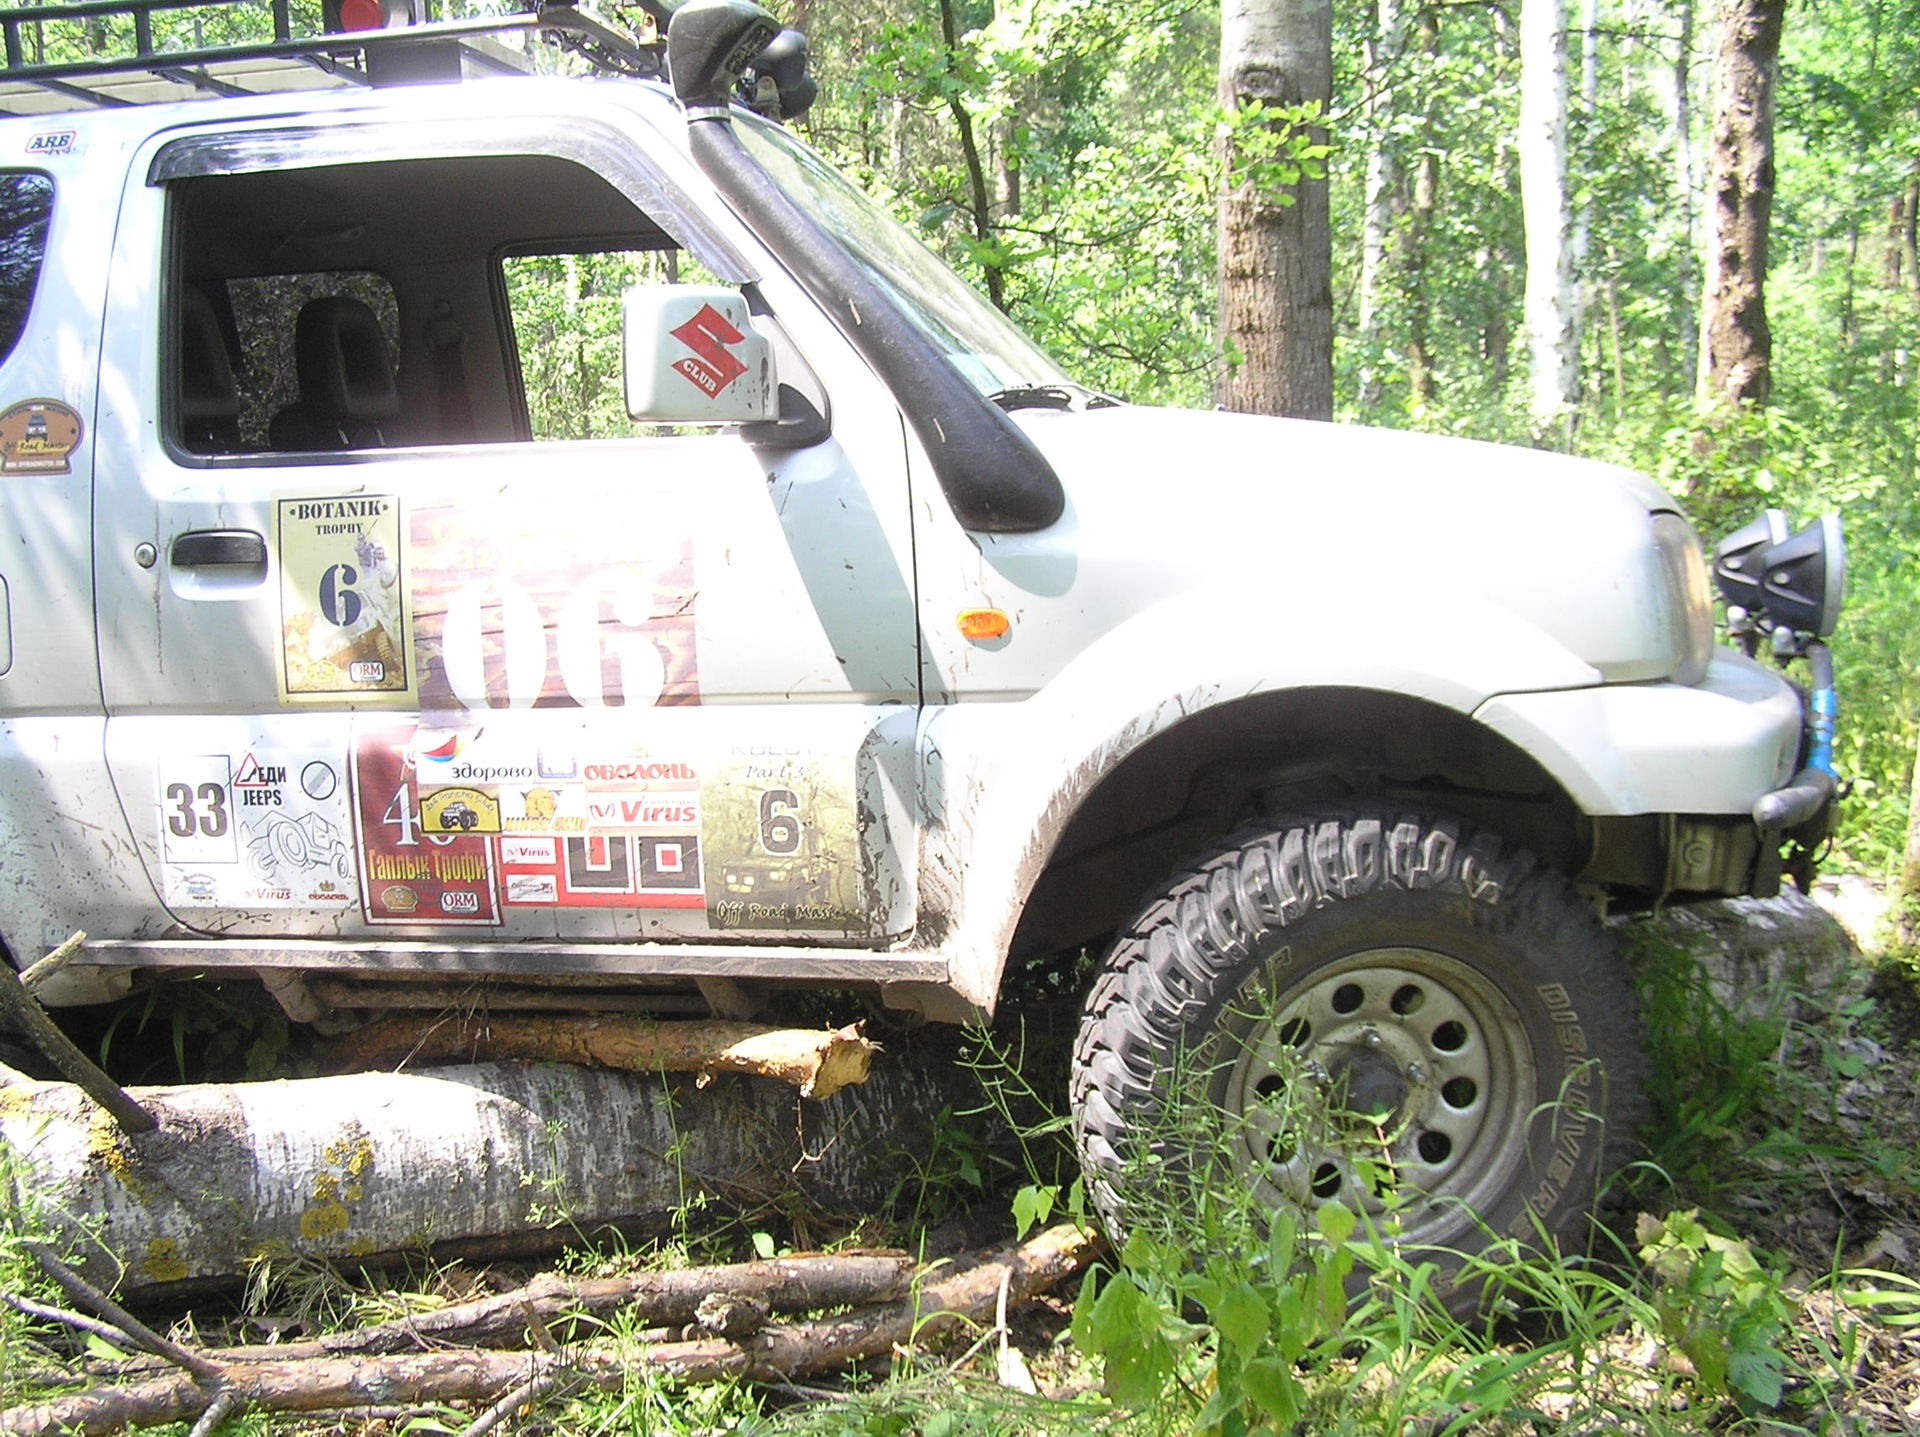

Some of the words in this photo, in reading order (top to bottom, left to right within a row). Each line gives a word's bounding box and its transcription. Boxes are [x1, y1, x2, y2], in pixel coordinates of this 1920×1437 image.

[30, 134, 71, 150] ARB
[683, 360, 717, 392] CLUB
[297, 500, 381, 520] BOTANIK
[315, 523, 364, 536] TROPHY
[319, 563, 362, 627] 6
[442, 570, 665, 712] 06
[354, 664, 382, 676] ORM
[451, 762, 533, 782] здорово
[747, 765, 786, 779] Part
[793, 766, 804, 779] 3
[243, 789, 283, 807] JEEPS
[167, 782, 228, 838] 33
[620, 800, 696, 822] Virus
[758, 786, 803, 856] 6
[519, 847, 550, 857] Virus
[368, 849, 431, 880] Гаплык
[431, 849, 487, 883] Трофи
[256, 887, 292, 900] Virus
[443, 893, 476, 906] ORM
[716, 900, 745, 926] Off
[748, 904, 787, 921] Road
